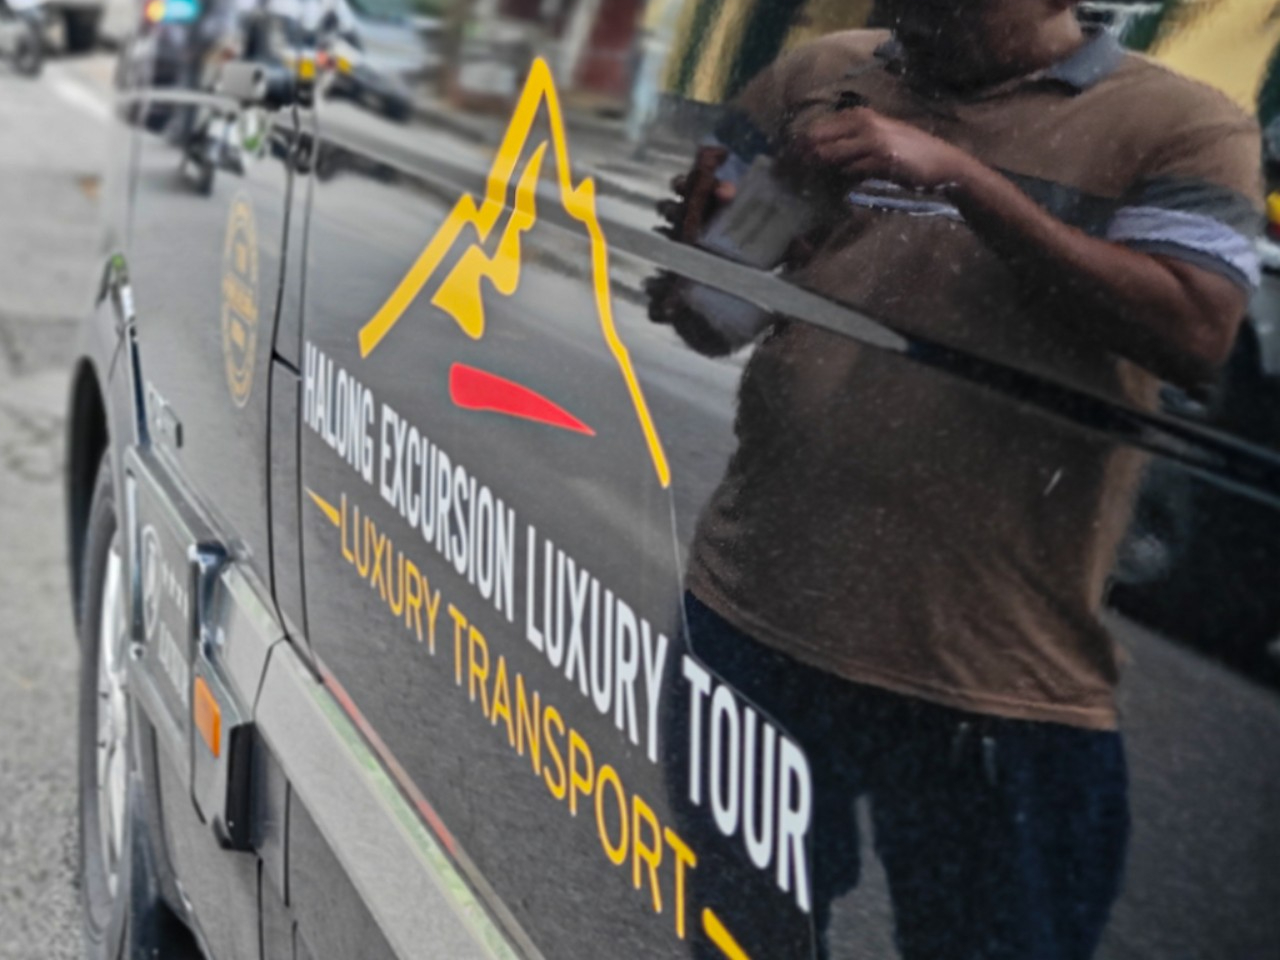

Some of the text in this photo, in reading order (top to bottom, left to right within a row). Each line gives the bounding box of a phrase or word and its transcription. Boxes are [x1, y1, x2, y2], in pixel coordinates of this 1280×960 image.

[304, 340, 812, 914] HALONG EXCURSION LUXURY TOUR
[340, 492, 697, 940] LUXURY TRANSPORT
